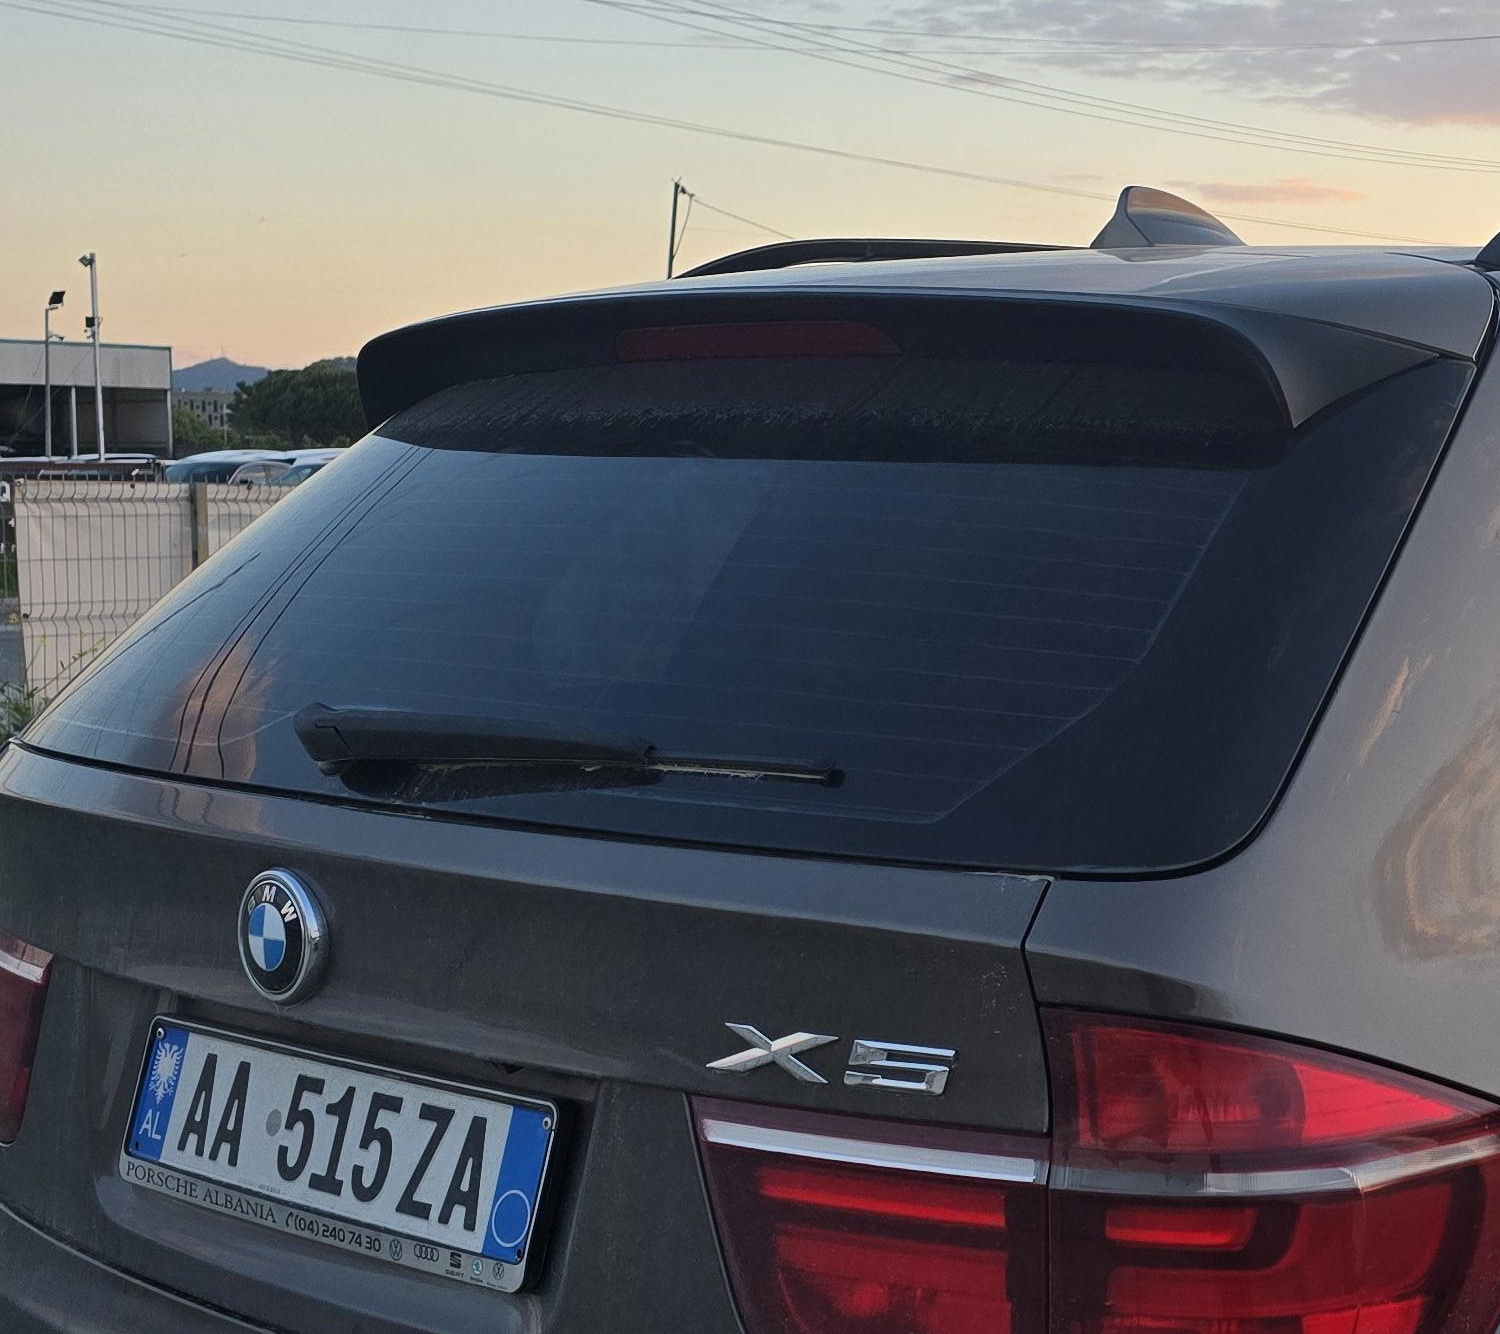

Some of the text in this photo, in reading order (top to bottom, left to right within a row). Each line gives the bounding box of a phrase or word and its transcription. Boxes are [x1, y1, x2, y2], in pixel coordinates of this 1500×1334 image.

[247, 884, 298, 923] BMW
[705, 1022, 956, 1096] X5
[138, 1108, 162, 1140] AL
[177, 1053, 251, 1167] AA
[126, 1160, 199, 1199] PORSCHE
[202, 1188, 277, 1224] ALBANIA
[295, 1214, 320, 1237] (04)
[321, 1223, 346, 1243] 240
[348, 1230, 363, 1249] 74
[365, 1235, 382, 1253] 30
